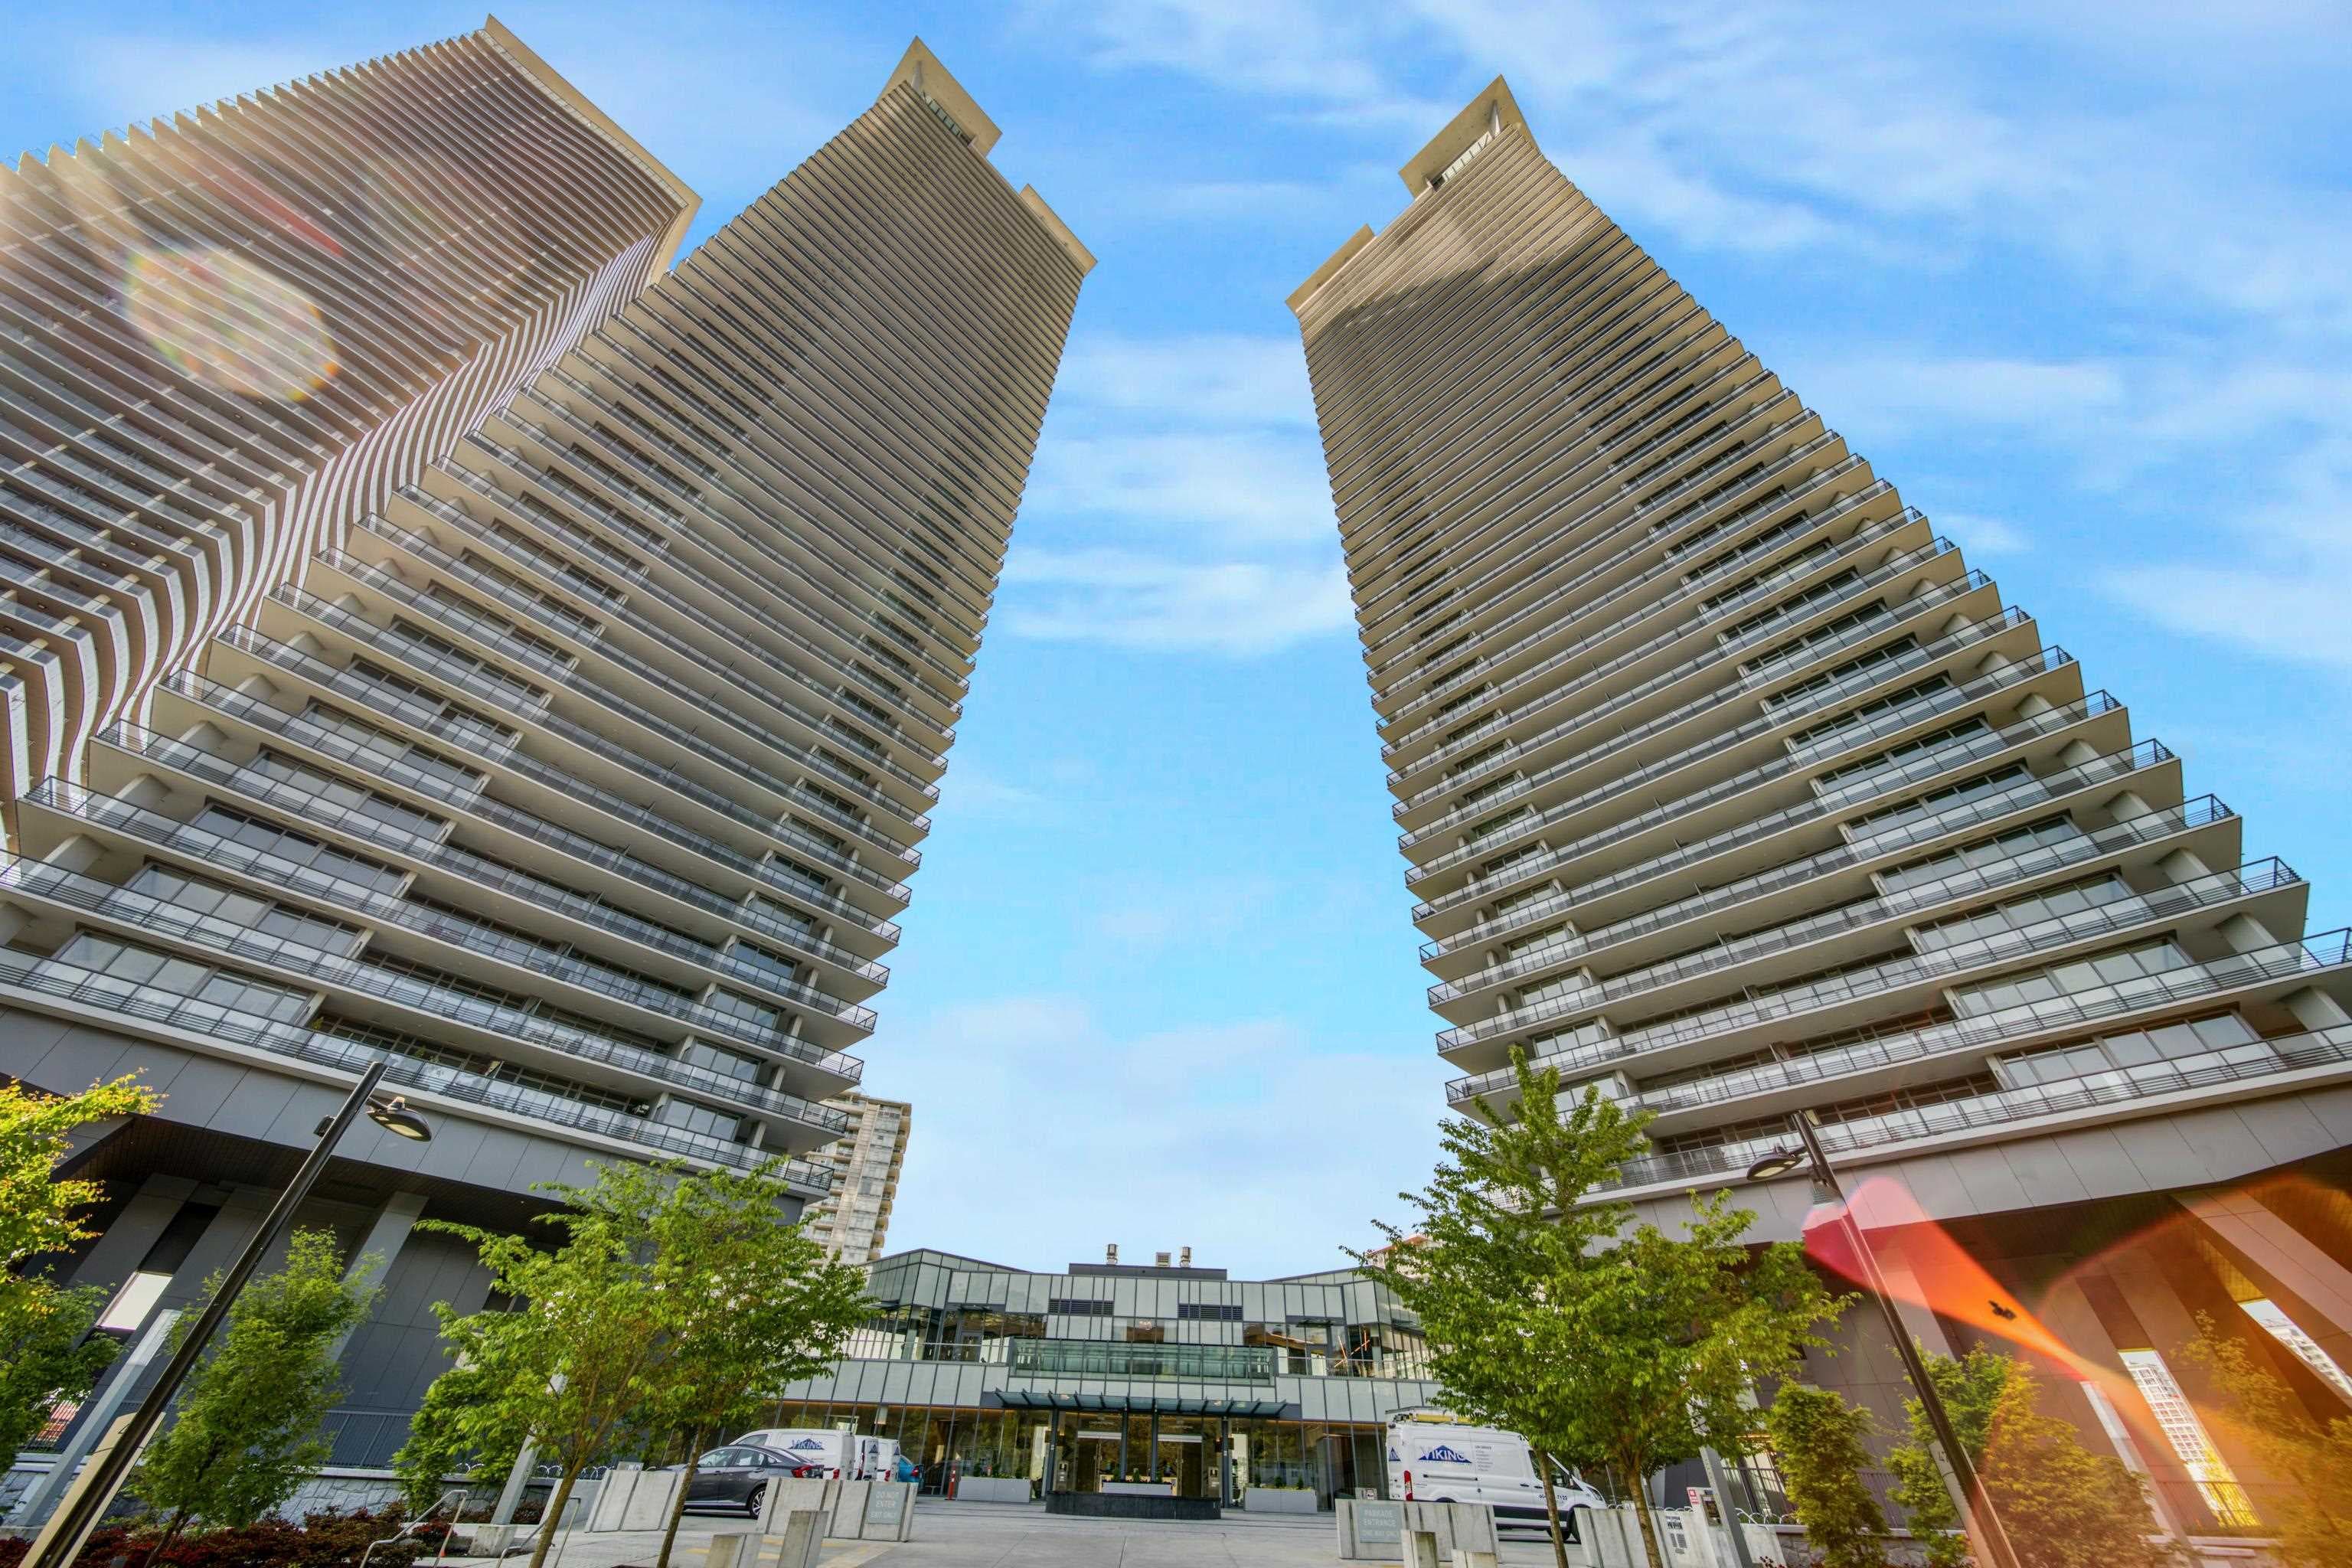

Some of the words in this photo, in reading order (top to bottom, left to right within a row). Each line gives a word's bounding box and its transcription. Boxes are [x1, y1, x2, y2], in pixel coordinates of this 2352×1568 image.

[792, 1439, 823, 1449] VIKING
[1419, 1446, 1468, 1462] VIKING
[1363, 1518, 1397, 1527] ENTRANCE
